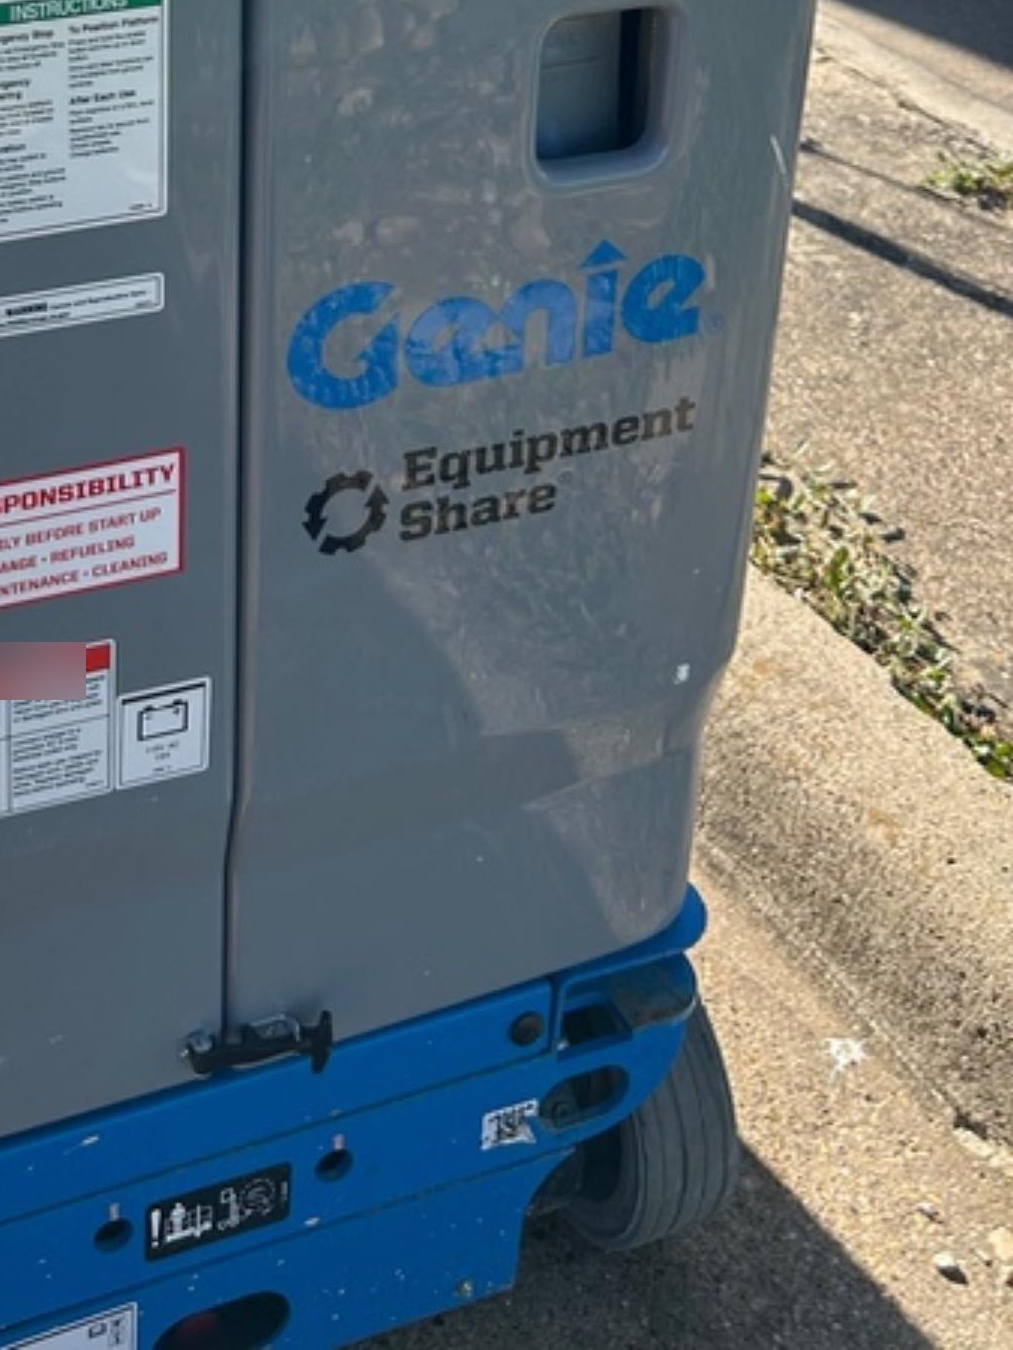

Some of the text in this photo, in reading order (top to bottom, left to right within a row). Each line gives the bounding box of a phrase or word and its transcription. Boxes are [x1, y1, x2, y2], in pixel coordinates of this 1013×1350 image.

[288, 240, 705, 410] Genie
[401, 396, 696, 489] Equipment
[26, 522, 84, 546] BEFORE
[88, 513, 136, 534] START
[139, 507, 162, 523] UP
[400, 481, 557, 541] Share
[49, 535, 136, 565] REFUELING
[91, 552, 168, 578] CLEANING
